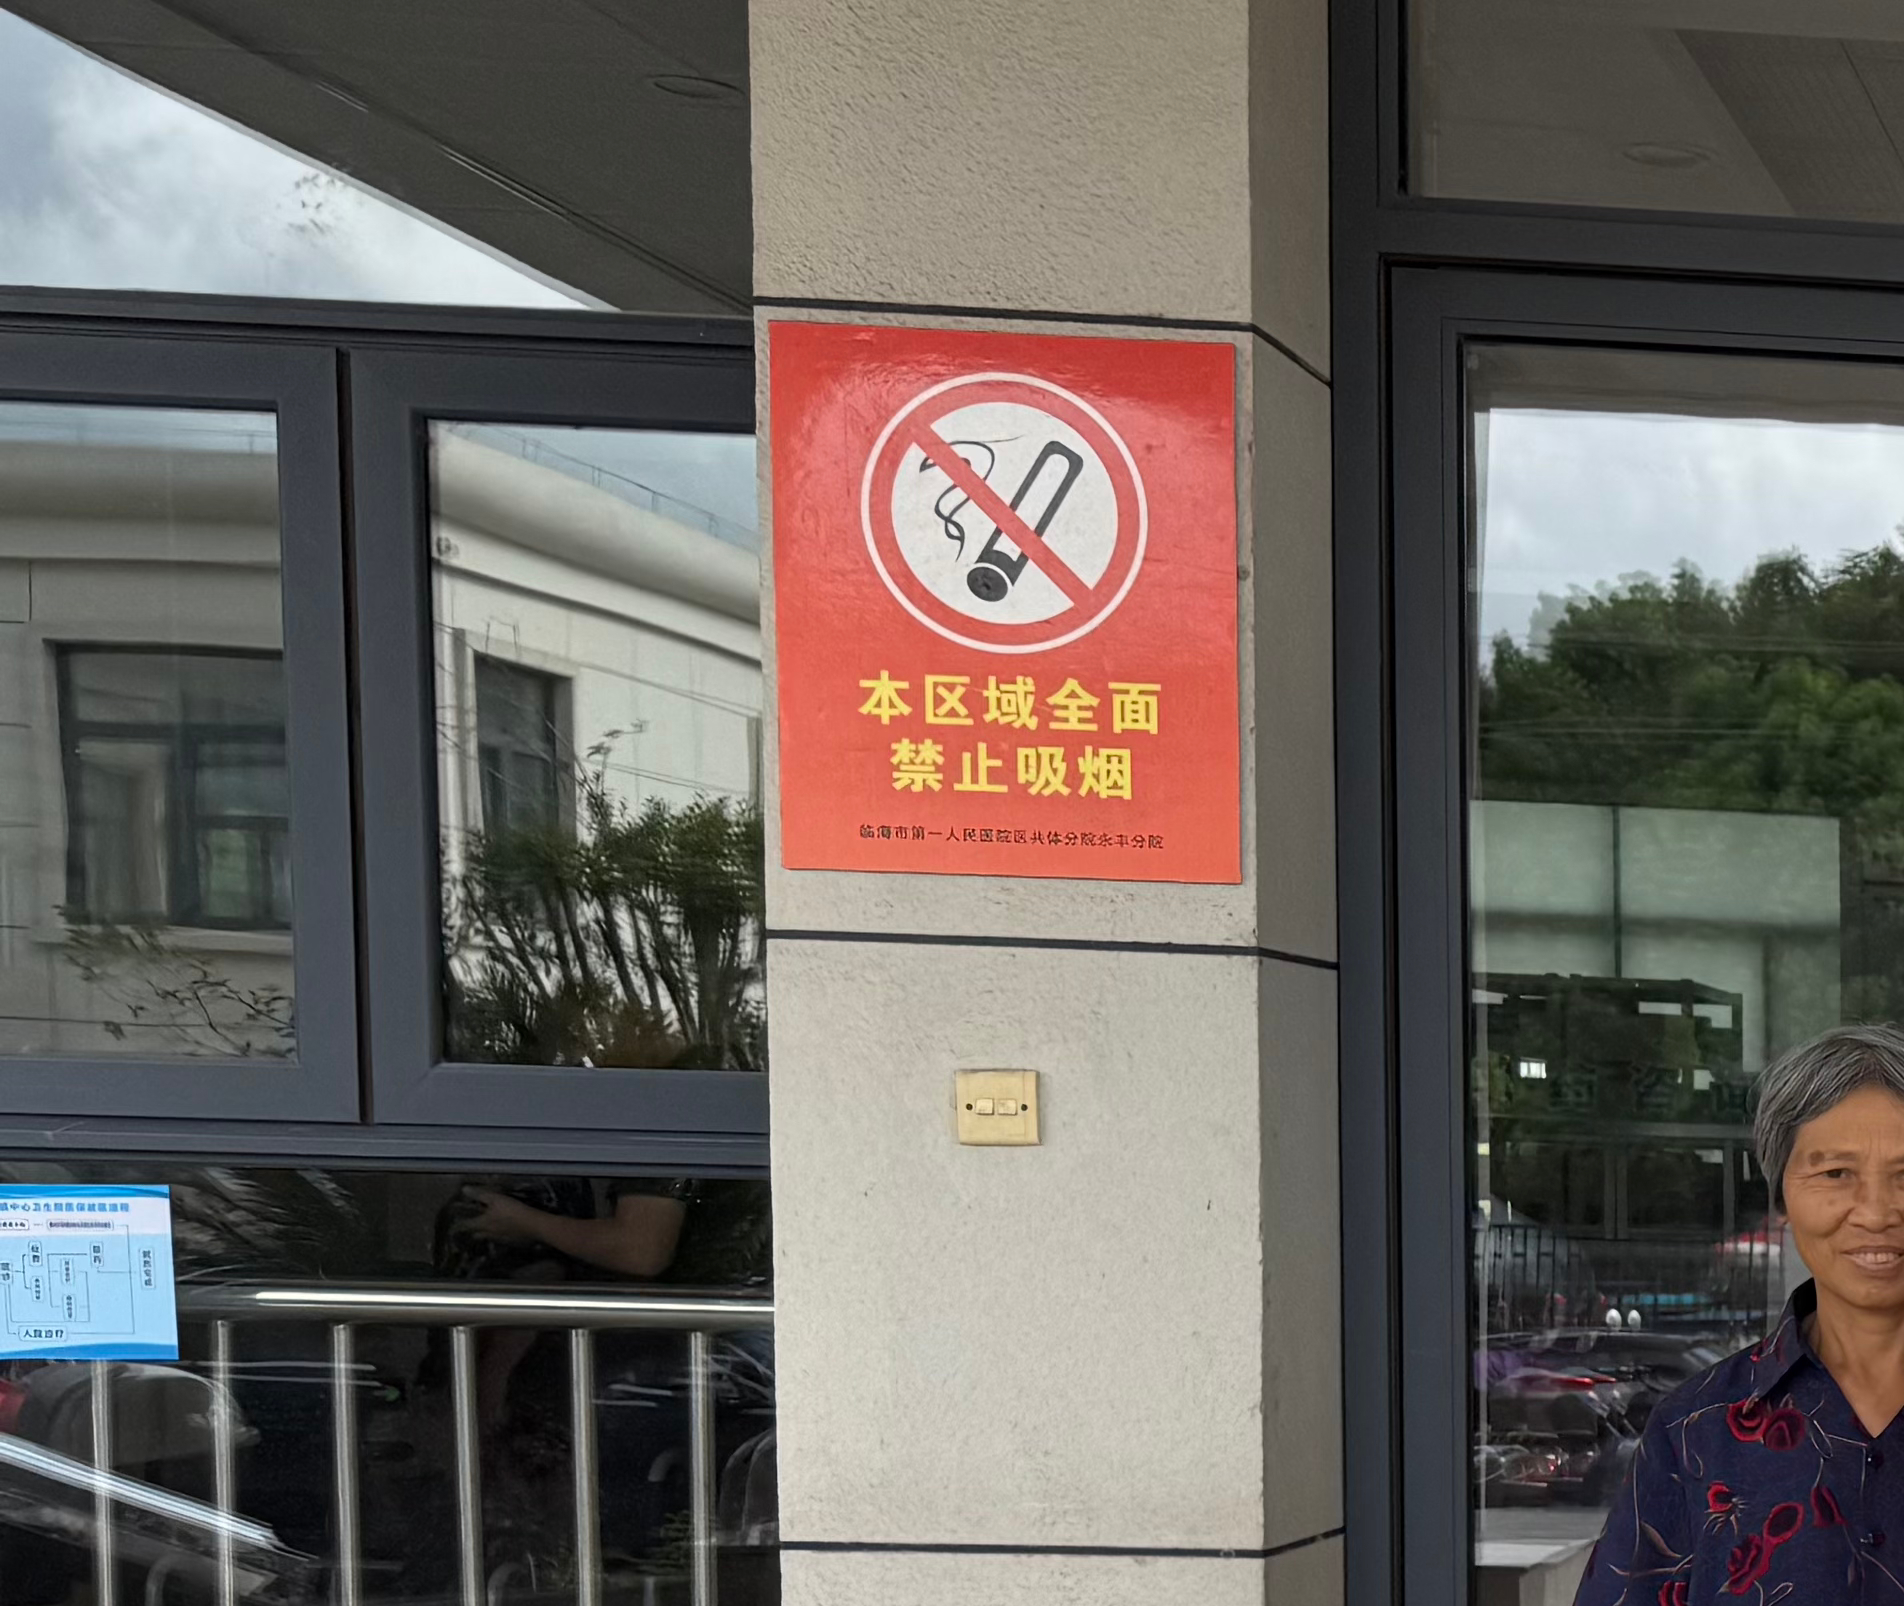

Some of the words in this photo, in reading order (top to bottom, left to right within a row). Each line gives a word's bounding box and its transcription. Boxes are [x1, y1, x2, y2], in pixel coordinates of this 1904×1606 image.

[858, 670, 1161, 735] 本区域全面
[890, 738, 1133, 799] 禁止吸烟
